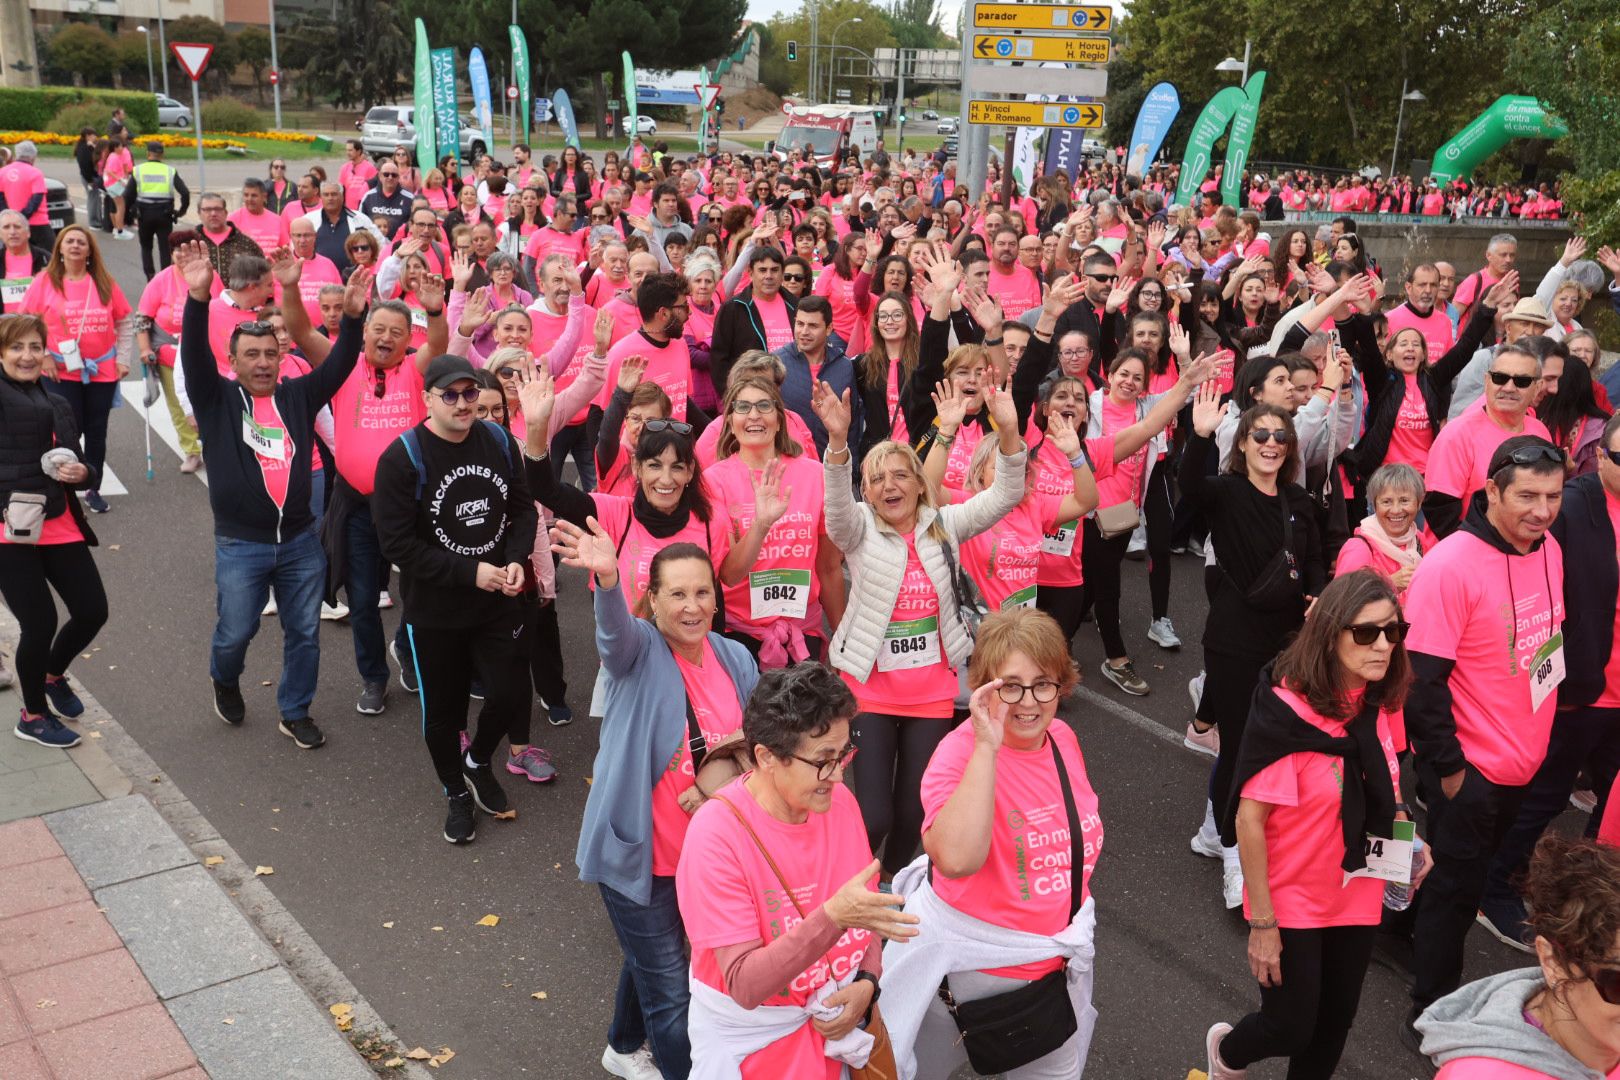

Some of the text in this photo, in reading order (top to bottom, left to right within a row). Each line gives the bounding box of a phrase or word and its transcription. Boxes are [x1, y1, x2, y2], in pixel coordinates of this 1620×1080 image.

[978, 12, 1017, 21] parador
[1079, 42, 1106, 50] Horus
[1080, 52, 1106, 61] Regio
[984, 104, 1010, 112] Vincci
[996, 114, 1032, 122] Romano
[1504, 114, 1530, 122] contra
[372, 206, 402, 216] adidas
[767, 335, 790, 343] ontra
[377, 390, 410, 401] archa
[362, 402, 411, 415] contra el
[250, 428, 272, 448] 5861
[1040, 468, 1054, 482] En
[430, 464, 492, 516] JACK&JONES
[742, 512, 812, 530] E archa
[764, 526, 812, 543] ntra el
[435, 528, 496, 556] COLLECTORS
[996, 565, 1038, 580] cánce
[764, 586, 796, 600] 6842
[900, 582, 936, 594] ontr
[897, 595, 937, 610] ánc
[1516, 618, 1530, 632] En
[890, 636, 926, 654] 6843
[1536, 658, 1552, 685] 808
[1028, 832, 1050, 848] En
[1015, 835, 1032, 901] SALAMANCA
